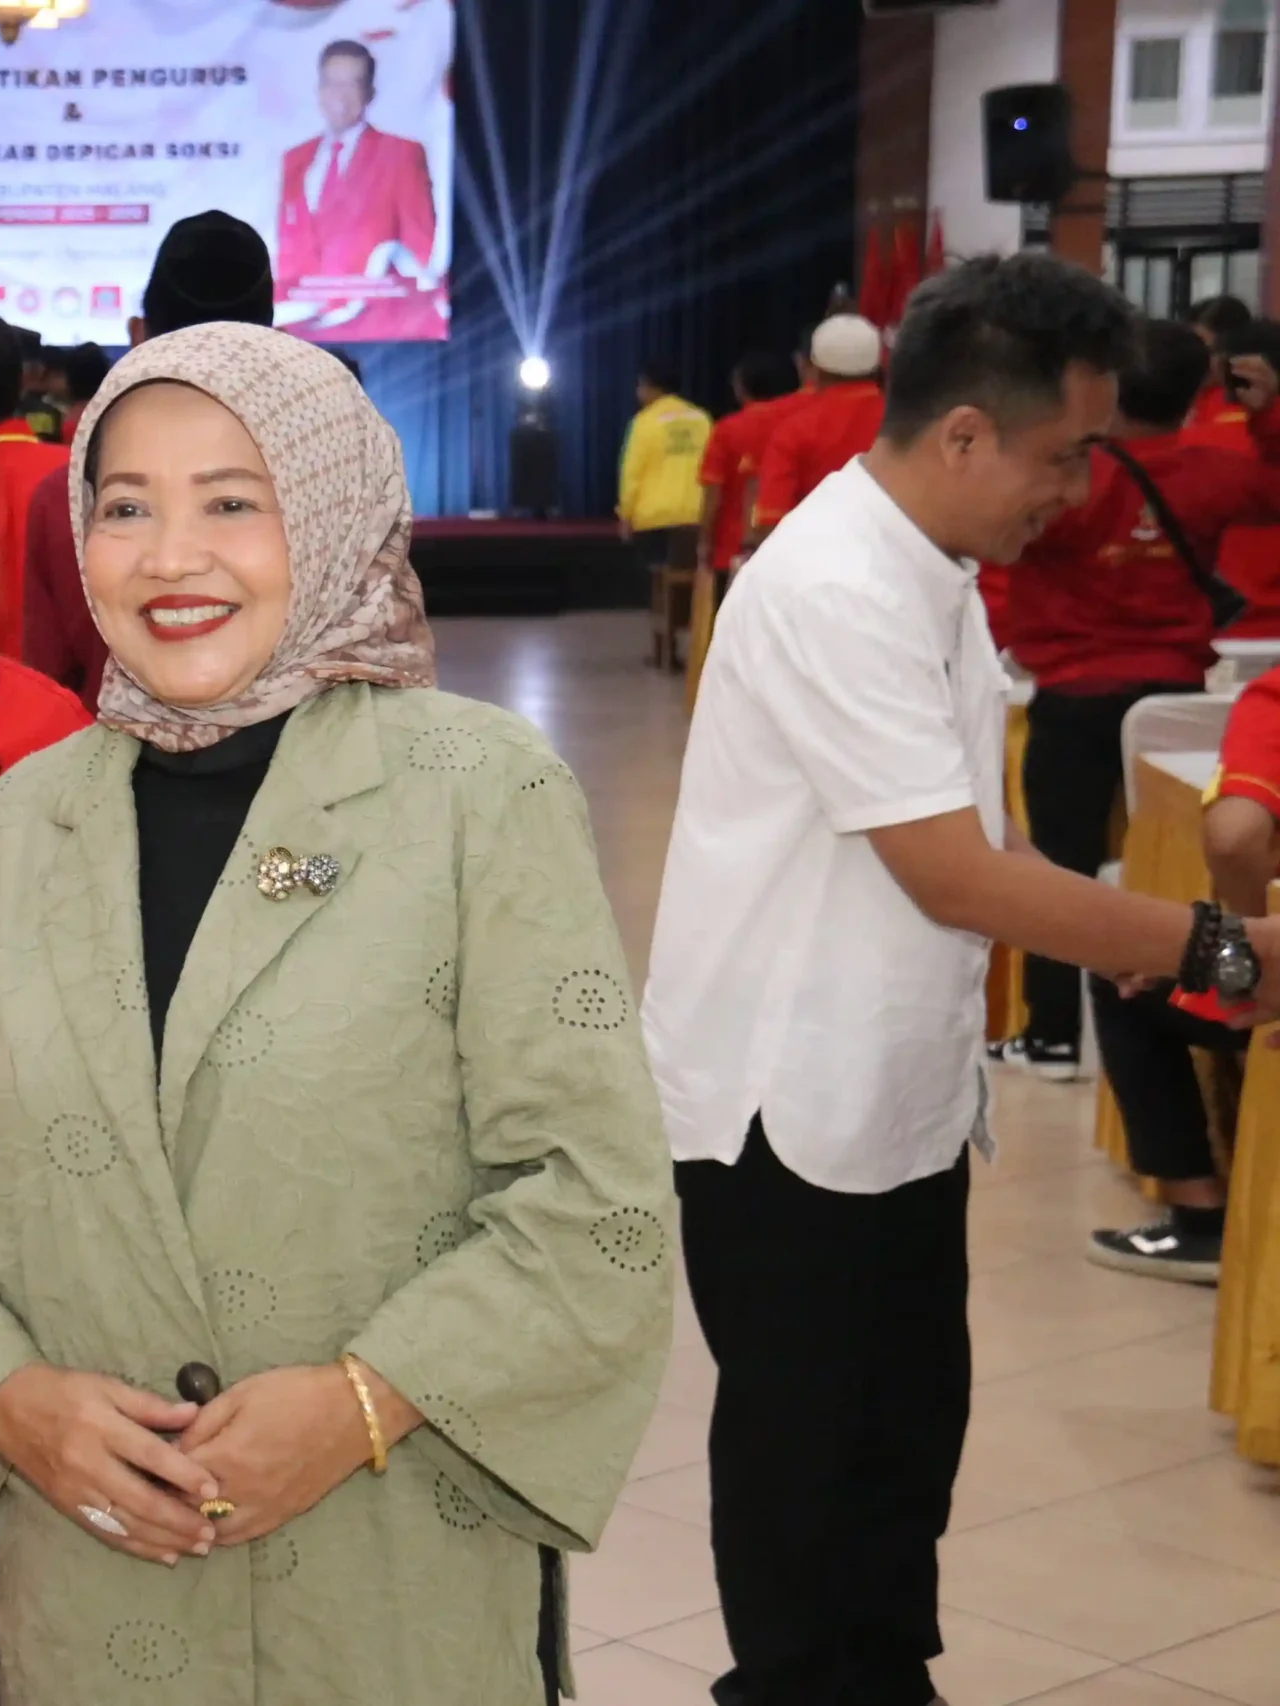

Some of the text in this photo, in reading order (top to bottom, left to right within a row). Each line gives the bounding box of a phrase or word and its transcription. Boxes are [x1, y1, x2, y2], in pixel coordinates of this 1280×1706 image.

[93, 66, 247, 87] PENGURUS
[63, 102, 82, 122] &
[166, 141, 240, 160] SOKSI
